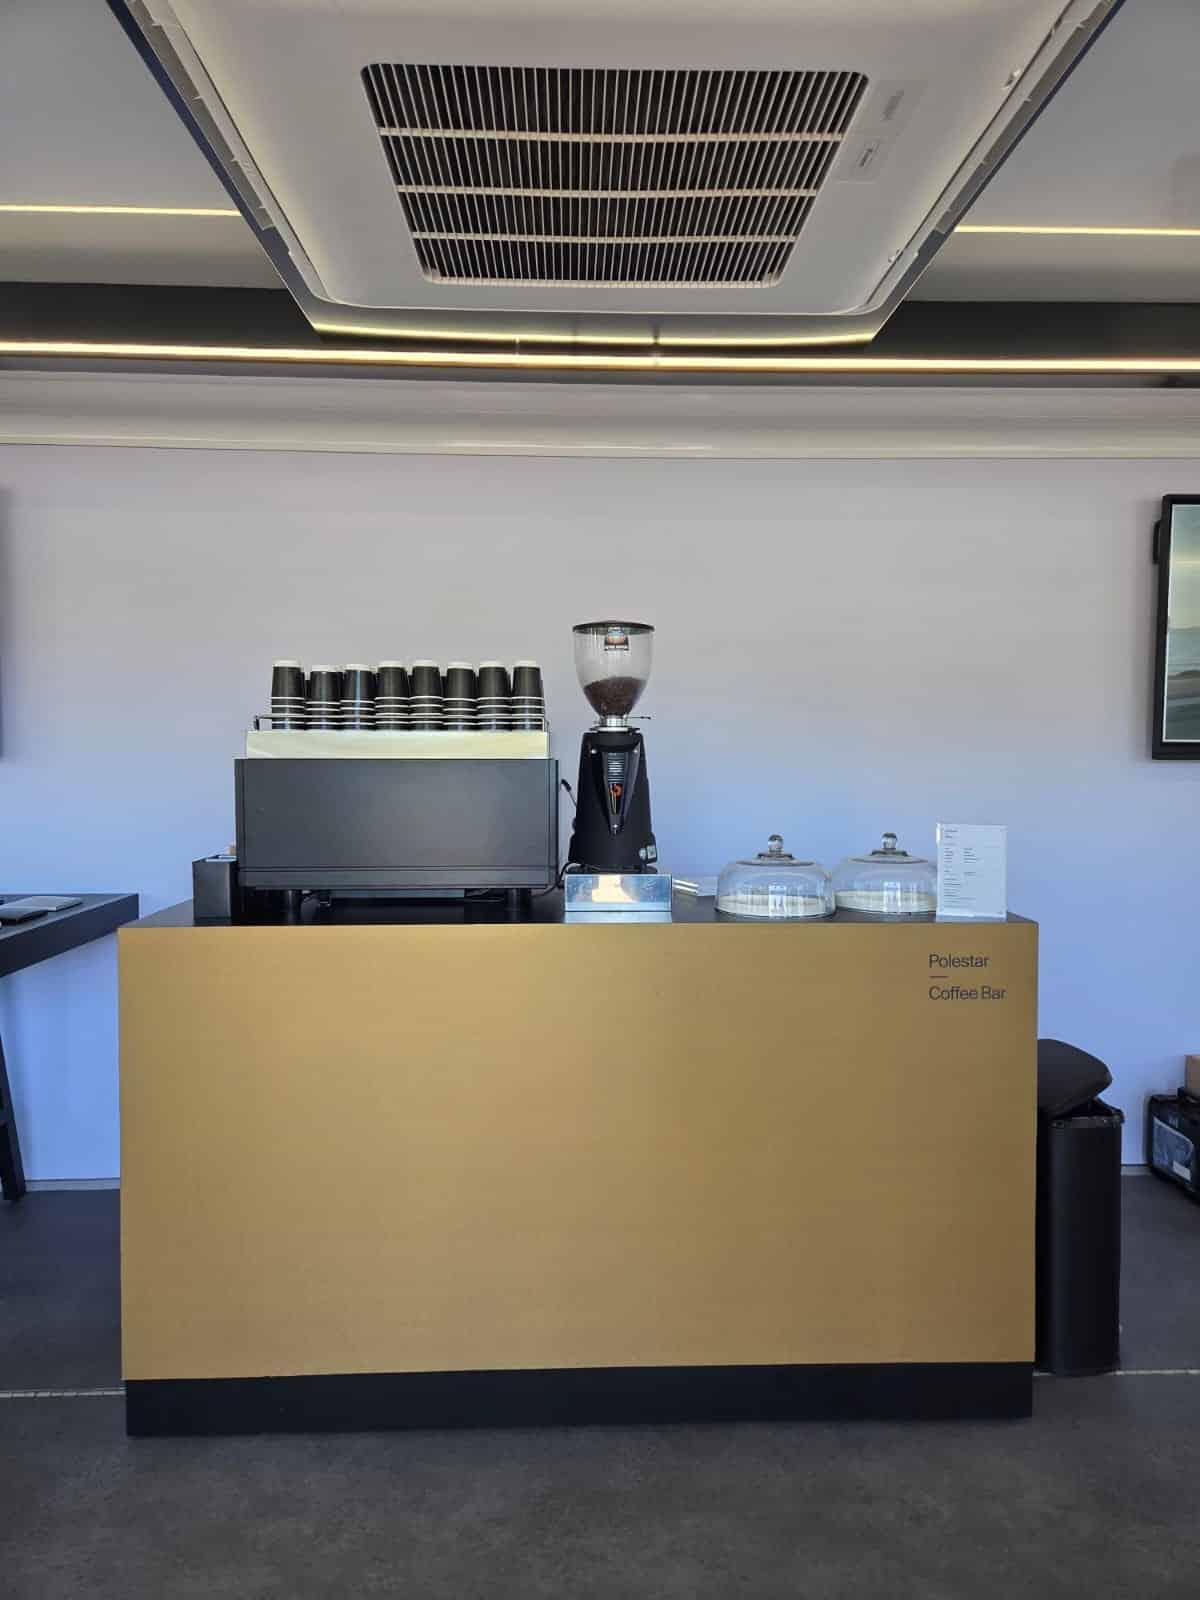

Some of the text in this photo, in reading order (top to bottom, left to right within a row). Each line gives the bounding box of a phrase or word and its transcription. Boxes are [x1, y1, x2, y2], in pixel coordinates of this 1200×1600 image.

[929, 953, 989, 968] Polestar
[929, 986, 1007, 1000] Coffee Bar
